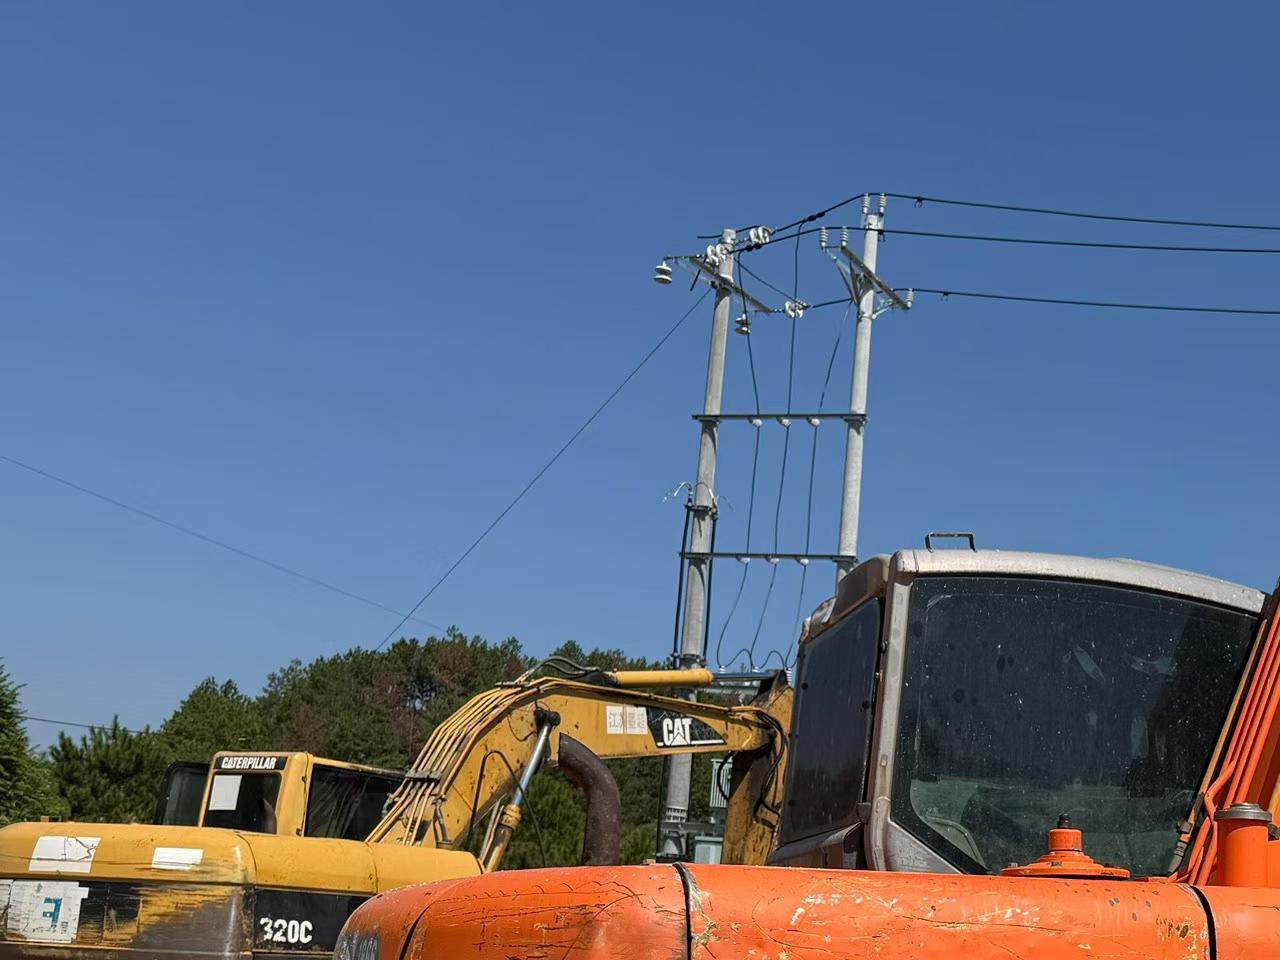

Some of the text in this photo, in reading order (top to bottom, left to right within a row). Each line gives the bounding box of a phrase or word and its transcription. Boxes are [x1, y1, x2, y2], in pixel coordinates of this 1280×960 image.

[662, 717, 694, 746] CAT
[220, 756, 277, 770] CATERPILLAR
[259, 917, 313, 944] 320C
